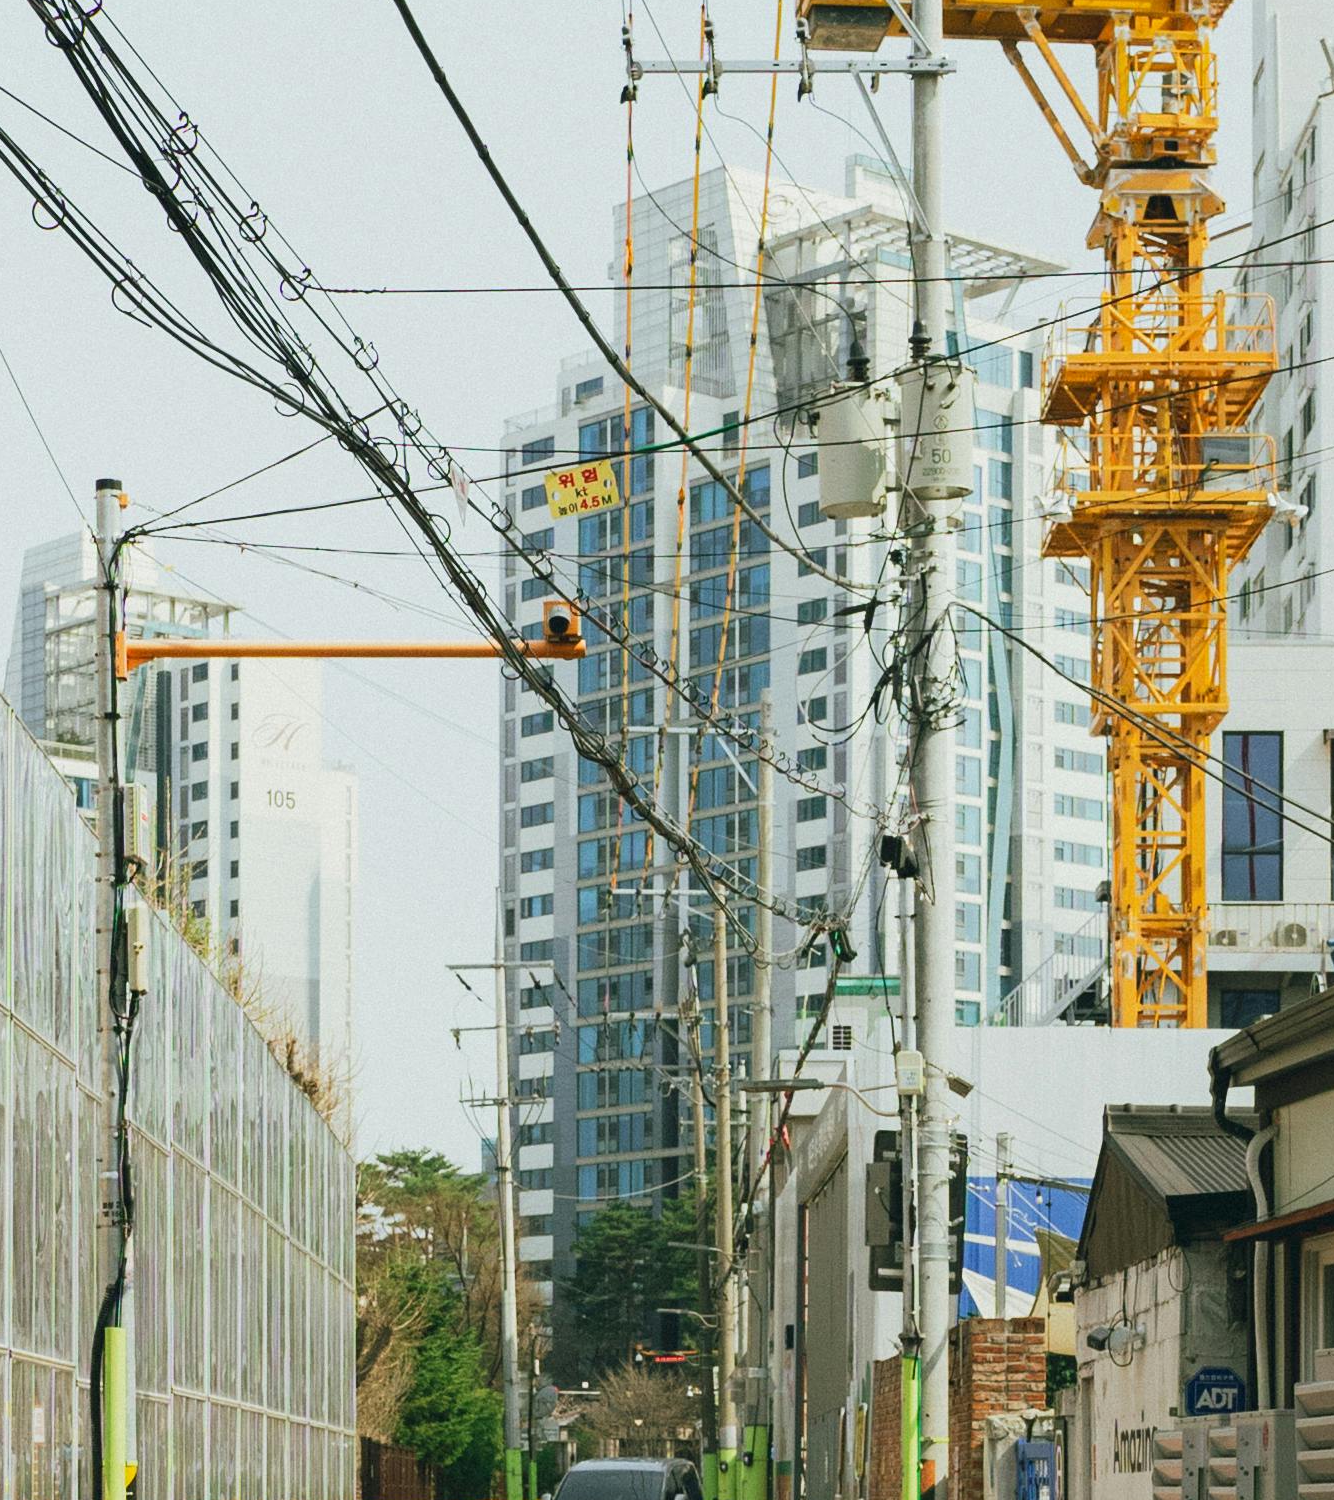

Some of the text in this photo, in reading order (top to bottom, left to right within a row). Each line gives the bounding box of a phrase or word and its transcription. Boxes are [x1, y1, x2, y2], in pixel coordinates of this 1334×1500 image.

[932, 448, 951, 464] 50
[558, 467, 599, 489] 위험
[266, 789, 296, 811] 105
[1195, 1387, 1238, 1409] ADT
